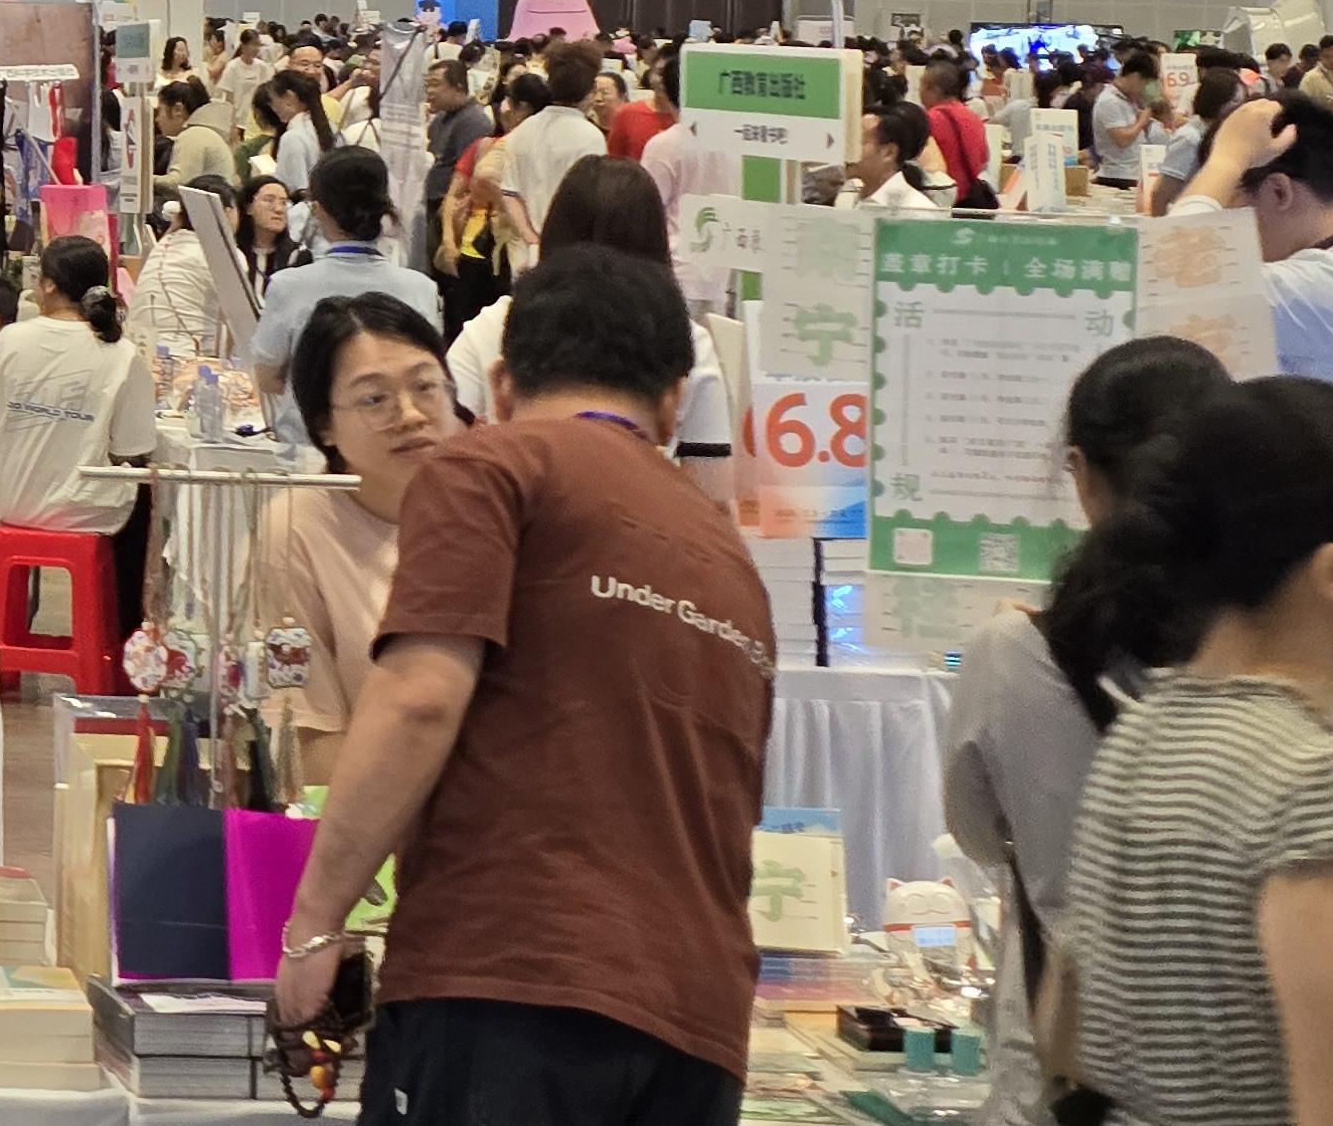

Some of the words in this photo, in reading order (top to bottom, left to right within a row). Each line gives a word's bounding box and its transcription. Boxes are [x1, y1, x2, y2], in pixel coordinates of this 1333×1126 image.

[894, 301, 925, 329] 活
[1085, 310, 1115, 337] 动
[63, 410, 95, 423] TOUR
[767, 392, 867, 468] 6.8
[591, 575, 676, 614] Under
